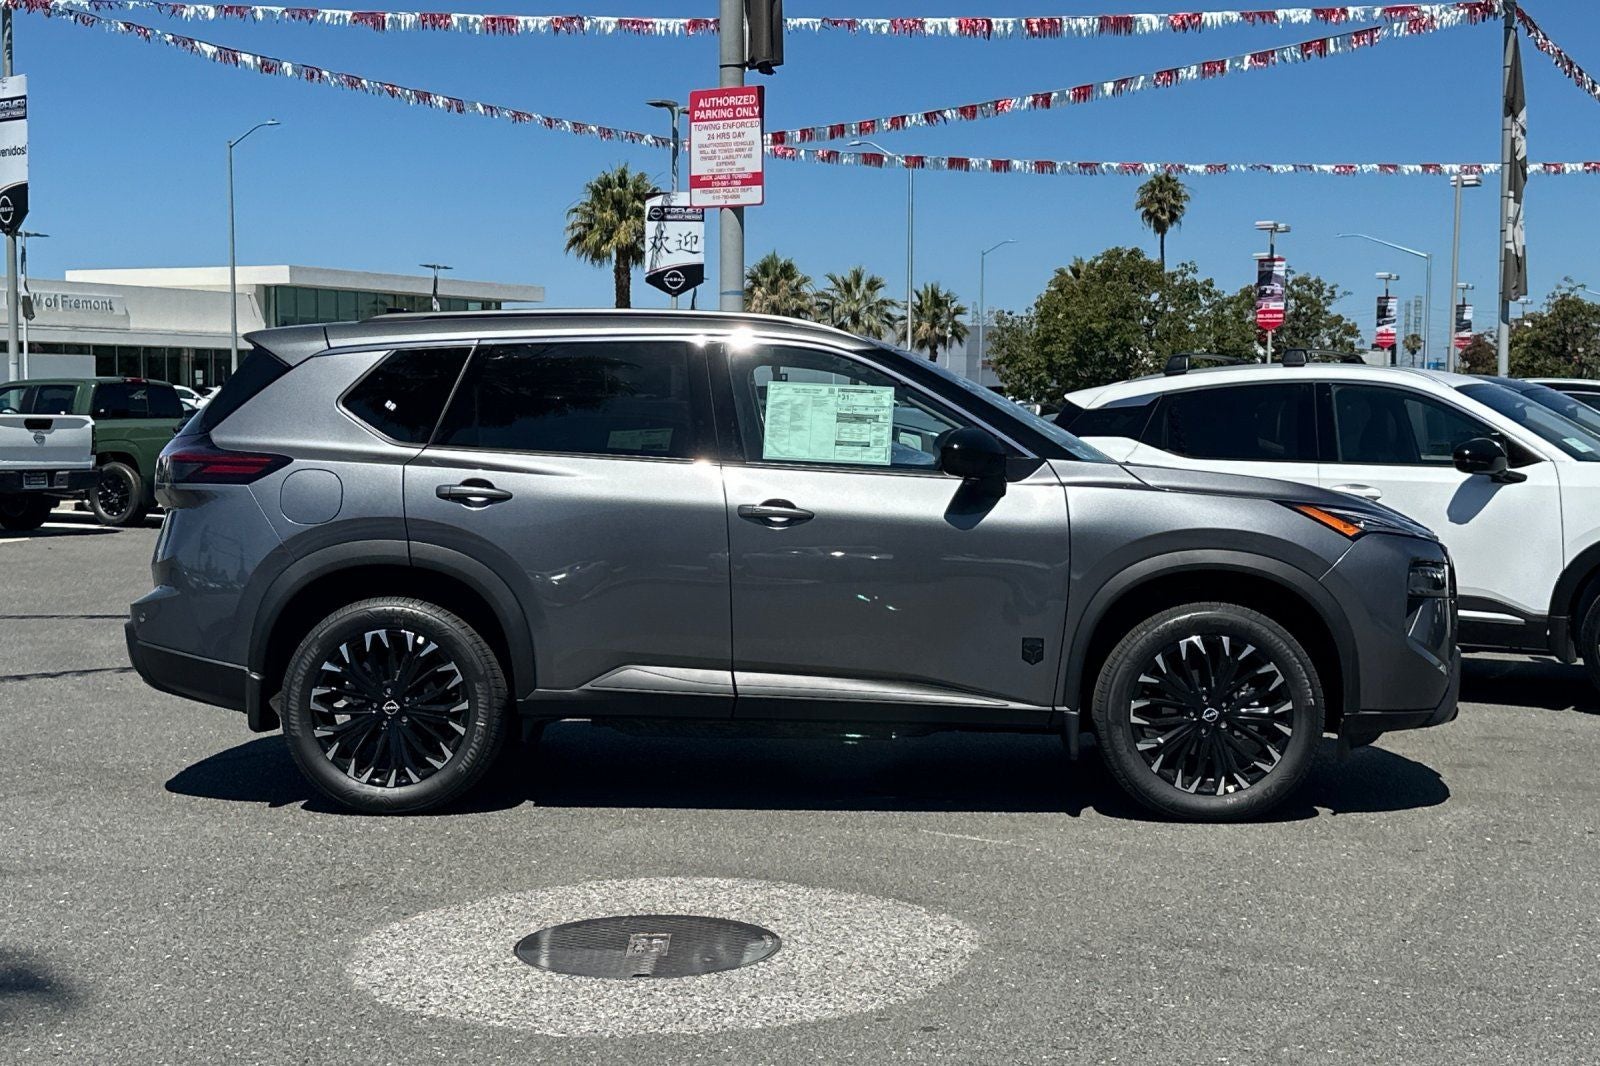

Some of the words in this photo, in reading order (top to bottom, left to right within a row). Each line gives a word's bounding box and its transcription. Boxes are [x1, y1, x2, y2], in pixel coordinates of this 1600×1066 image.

[698, 94, 756, 108] AUTHORIZED
[694, 108, 734, 120] PARKING
[736, 106, 760, 118] ONLY
[694, 123, 721, 132] TOWING
[722, 120, 760, 130] ENFORCED
[707, 133, 715, 141] 24
[716, 132, 731, 140] HRS
[732, 131, 746, 139] DAY
[0, 144, 27, 157] enidos!
[44, 293, 58, 308] of
[60, 294, 115, 312] Fremont
